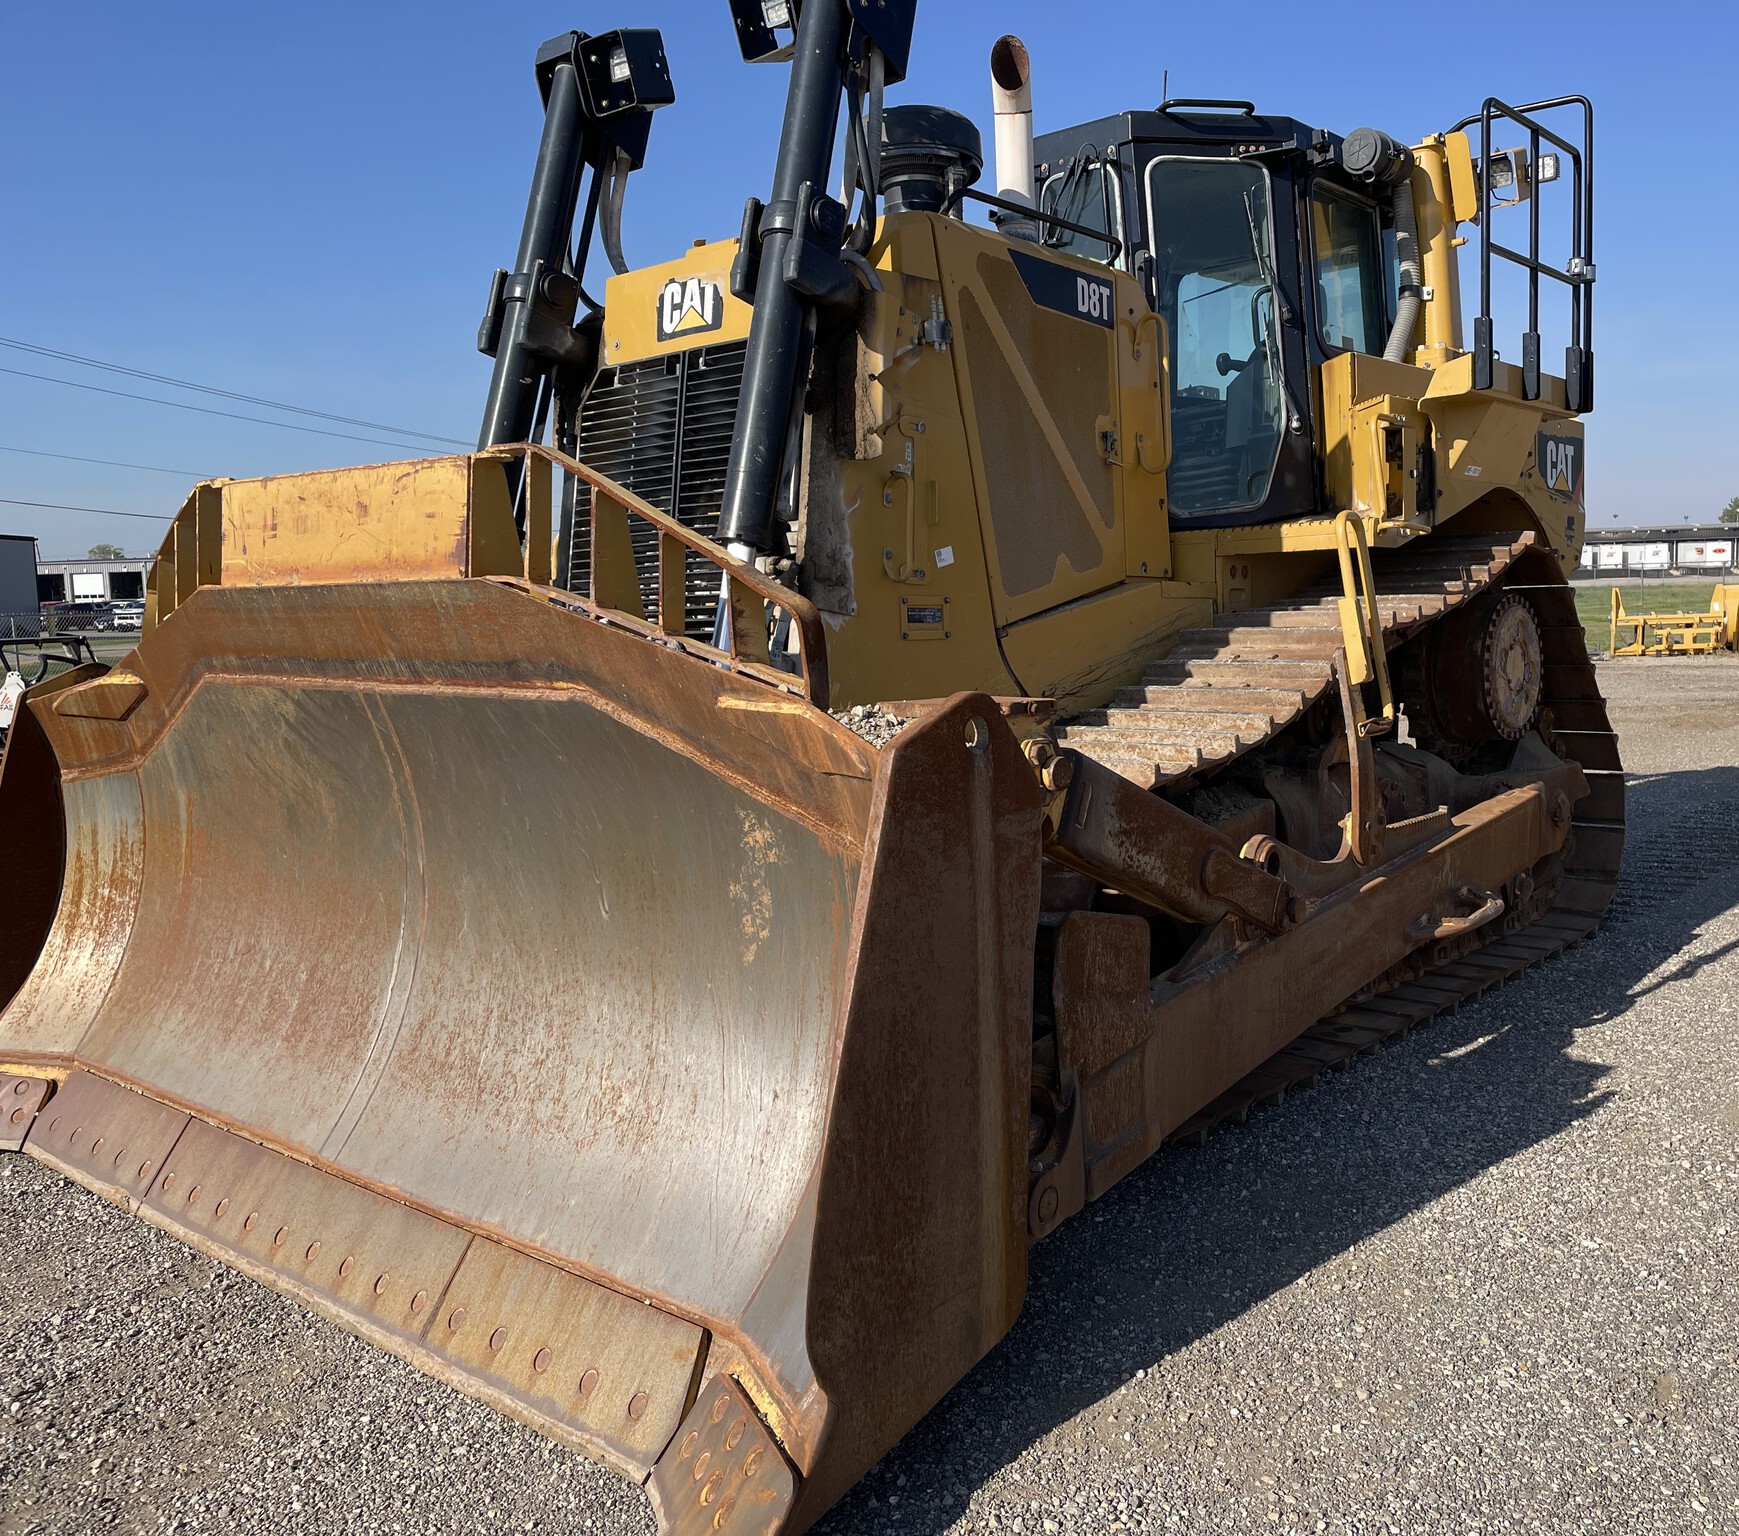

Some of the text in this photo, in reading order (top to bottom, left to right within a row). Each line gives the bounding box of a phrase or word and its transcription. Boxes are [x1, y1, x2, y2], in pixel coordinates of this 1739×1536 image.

[662, 278, 714, 334] CAT
[1076, 277, 1110, 321] D8T
[1546, 440, 1575, 492] CAT
